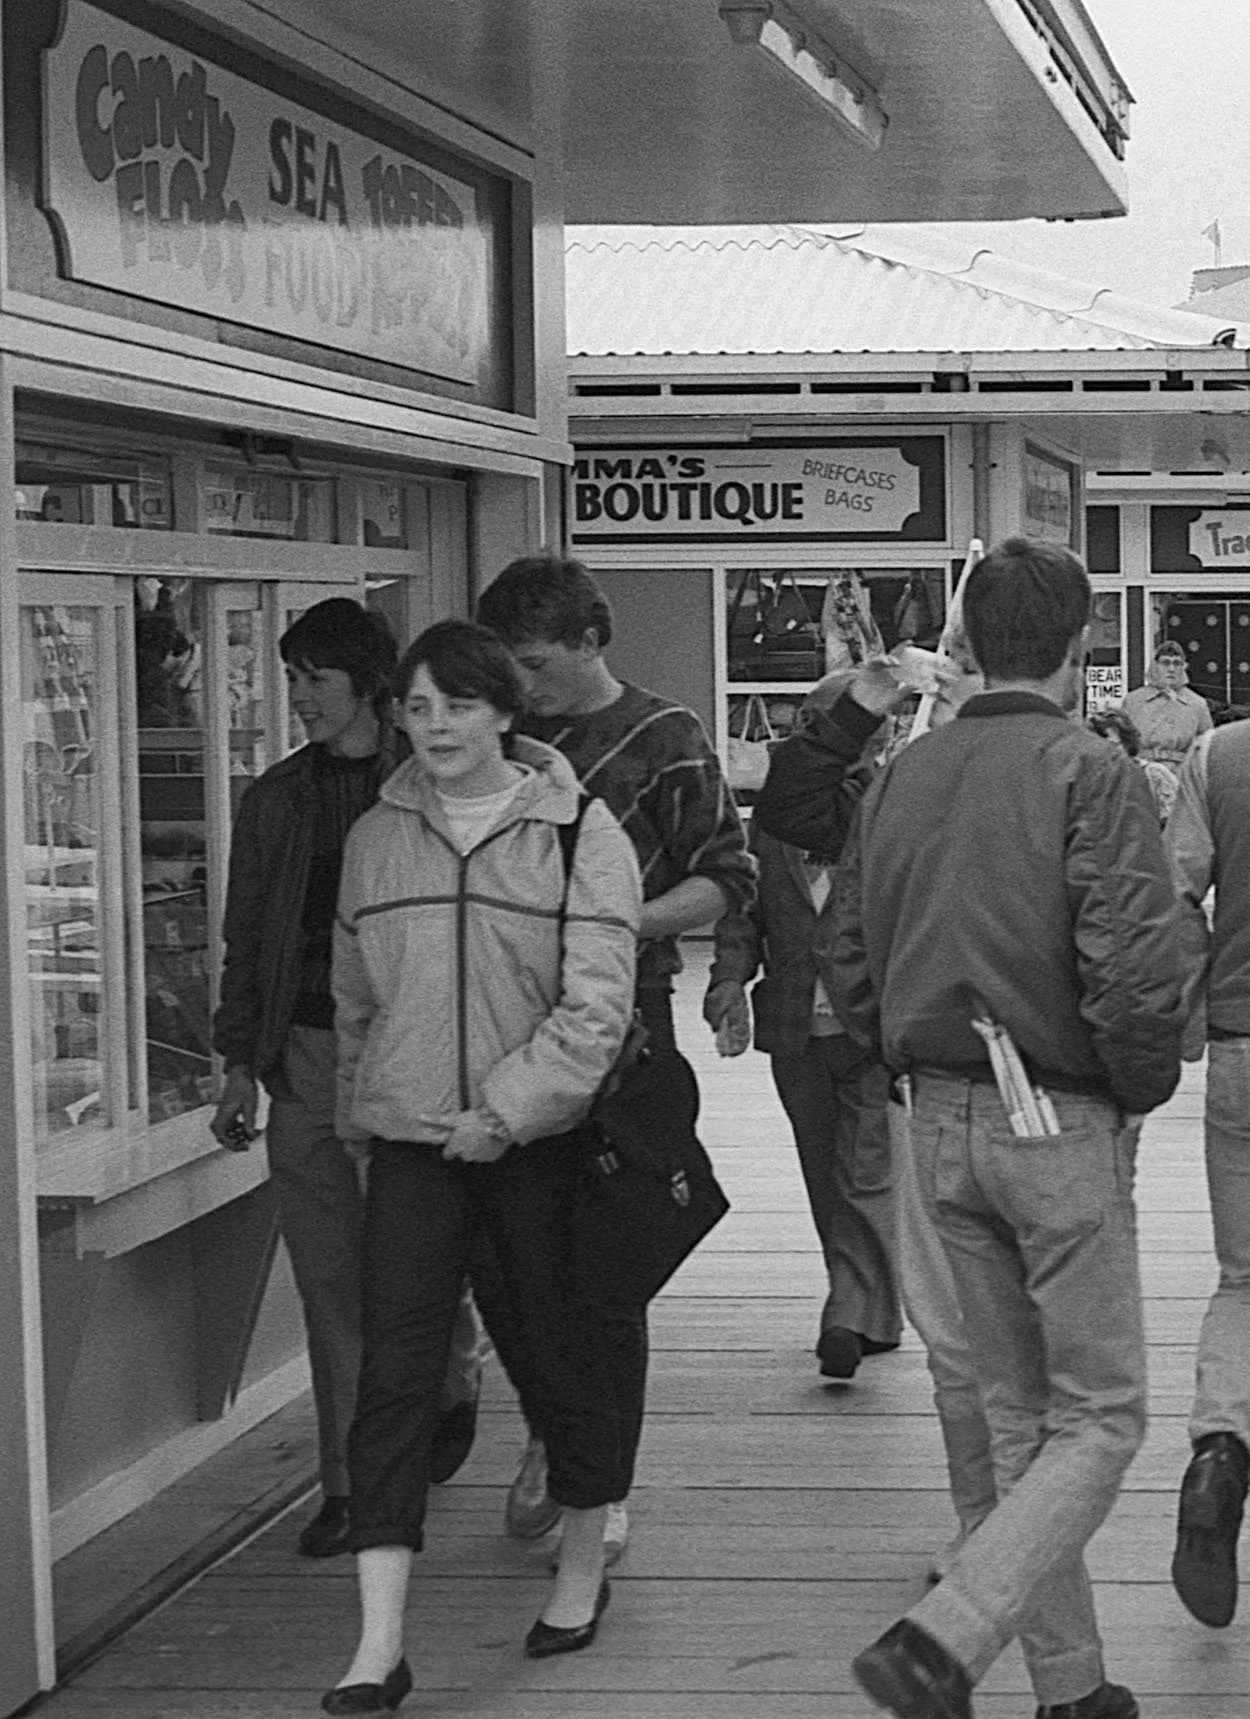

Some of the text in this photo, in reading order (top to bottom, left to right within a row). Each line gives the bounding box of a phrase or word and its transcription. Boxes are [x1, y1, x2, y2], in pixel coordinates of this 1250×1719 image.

[76, 44, 236, 192] Candy
[268, 118, 351, 233] SEA
[801, 459, 897, 491] BRIEFCASES
[575, 482, 804, 526] BOUTIQUE
[824, 488, 874, 512] BAGS
[1088, 668, 1122, 682] BEAR
[1091, 684, 1122, 698] TIME
